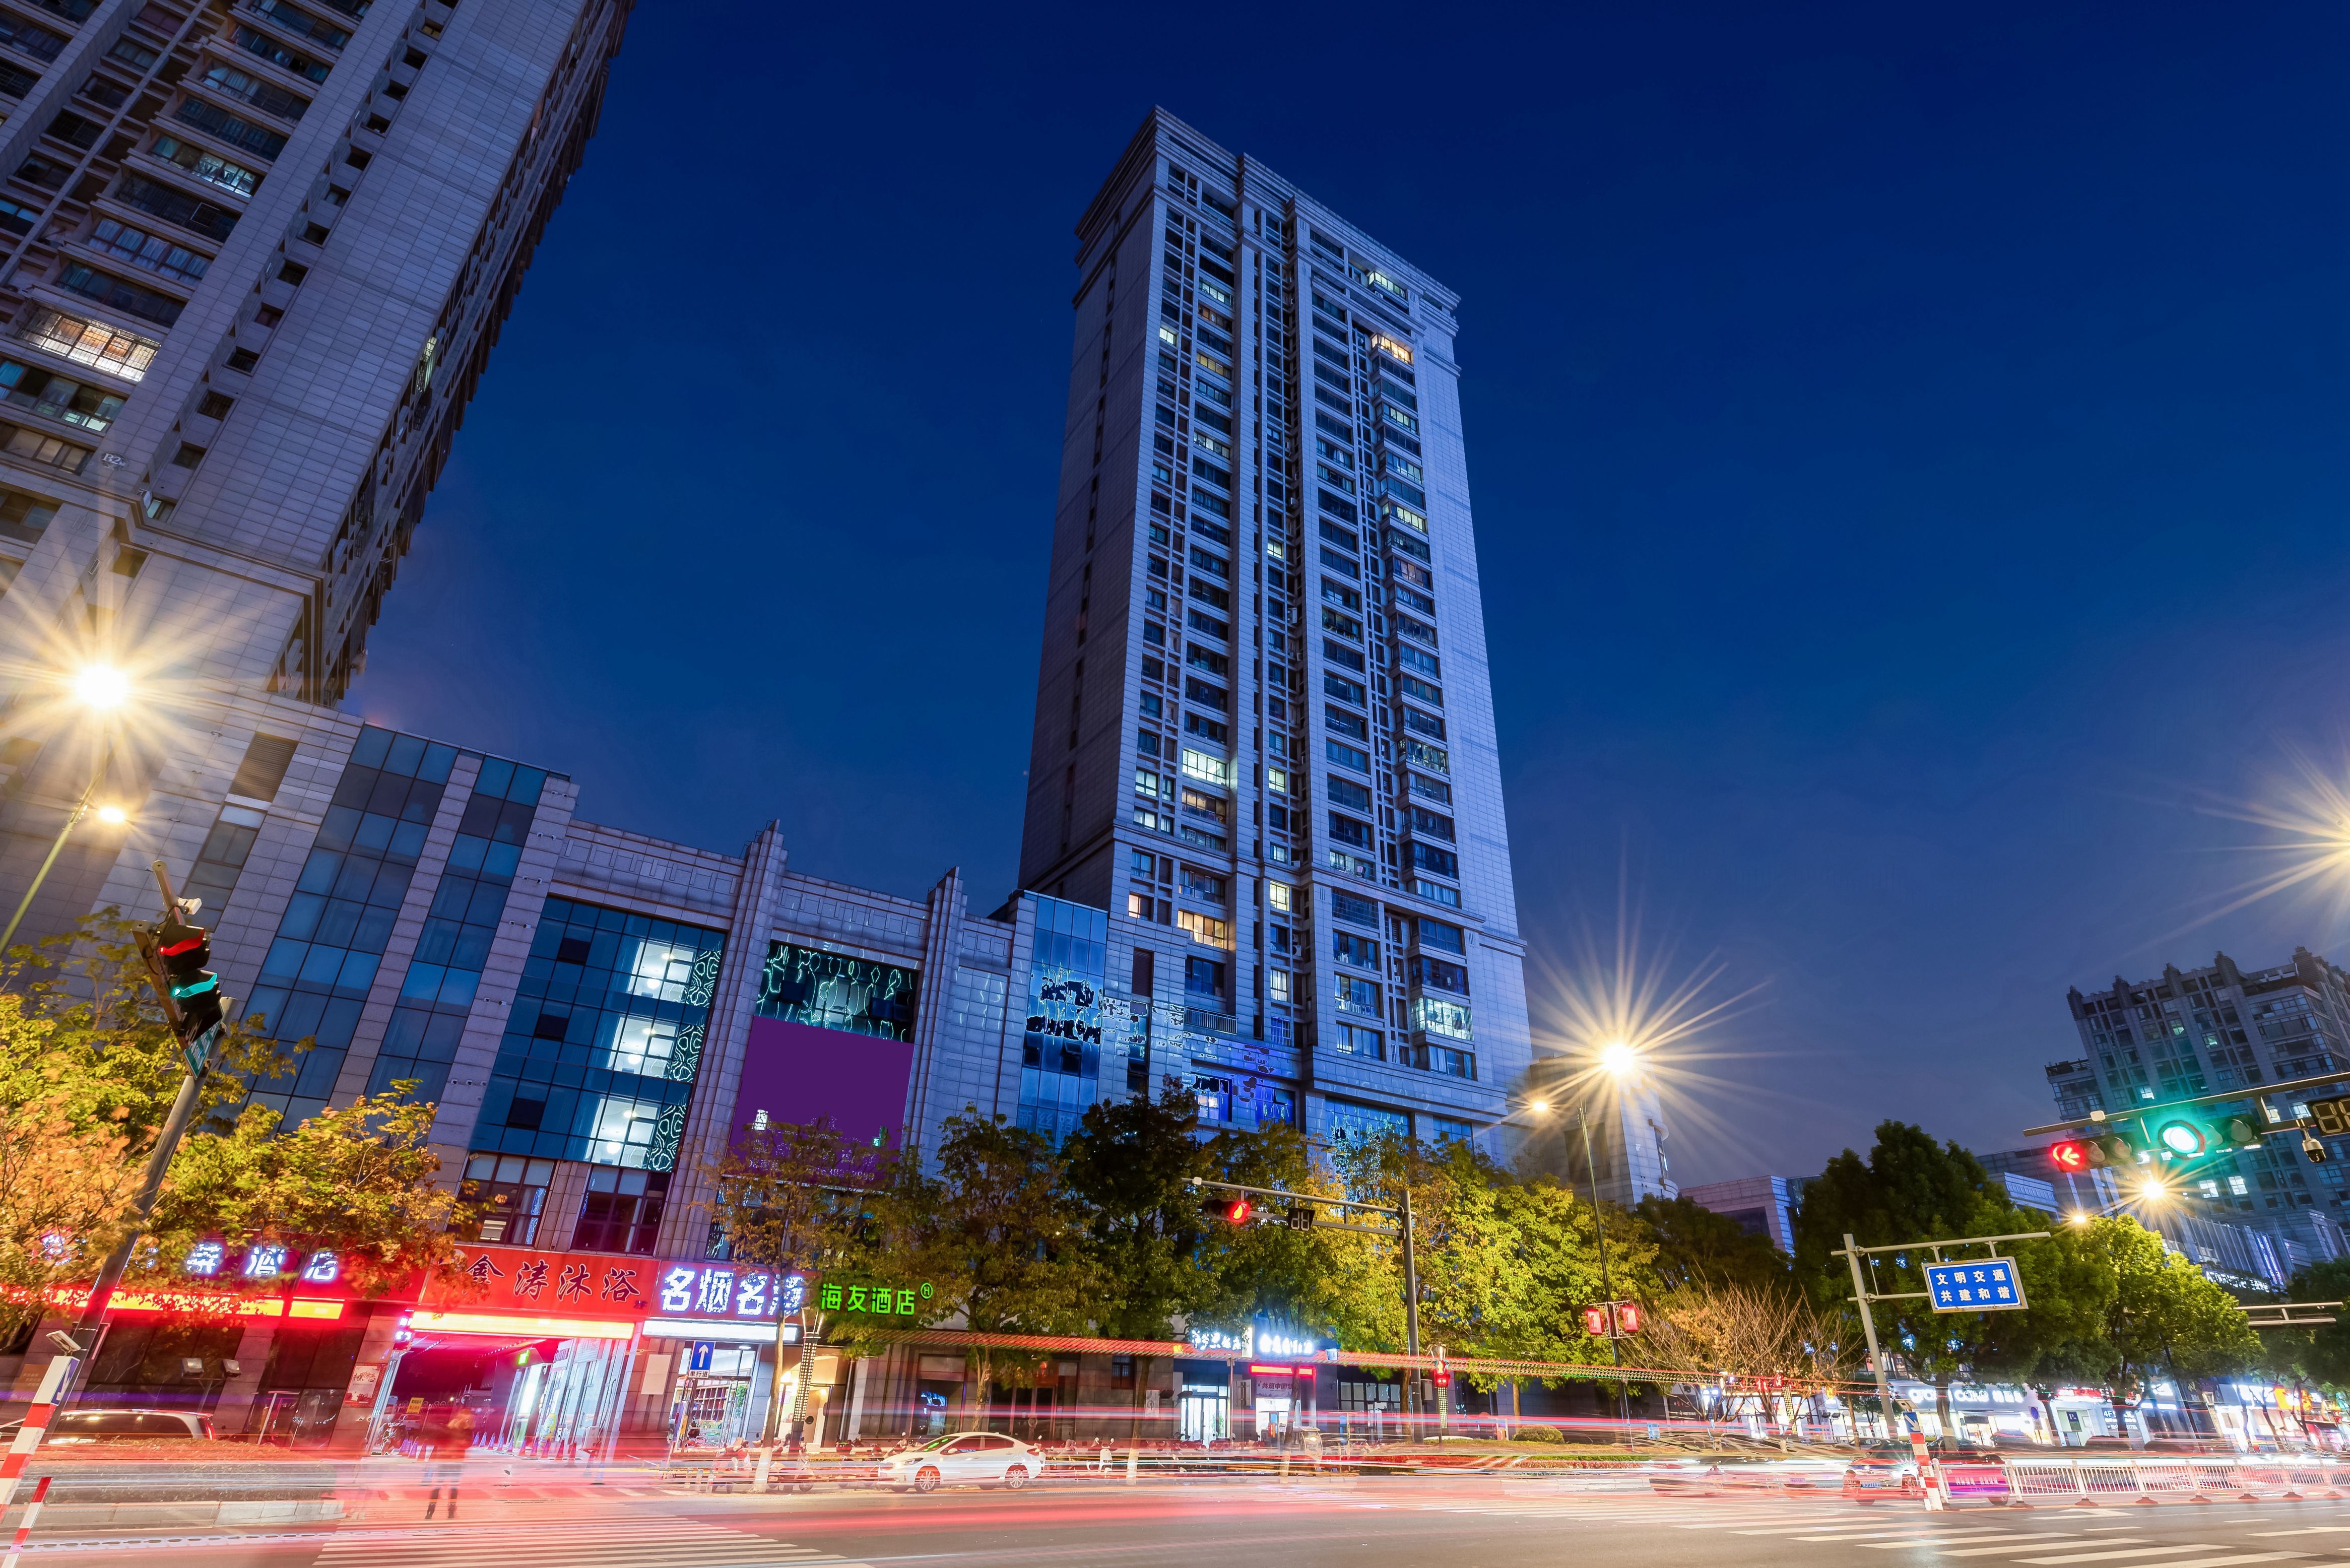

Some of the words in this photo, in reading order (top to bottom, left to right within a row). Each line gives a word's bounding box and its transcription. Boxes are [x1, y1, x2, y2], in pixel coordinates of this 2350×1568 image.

[1935, 1269, 2006, 1285] 文明交通
[821, 1283, 916, 1316] 海友酒店
[1940, 1286, 2010, 1302] 共建和谐
